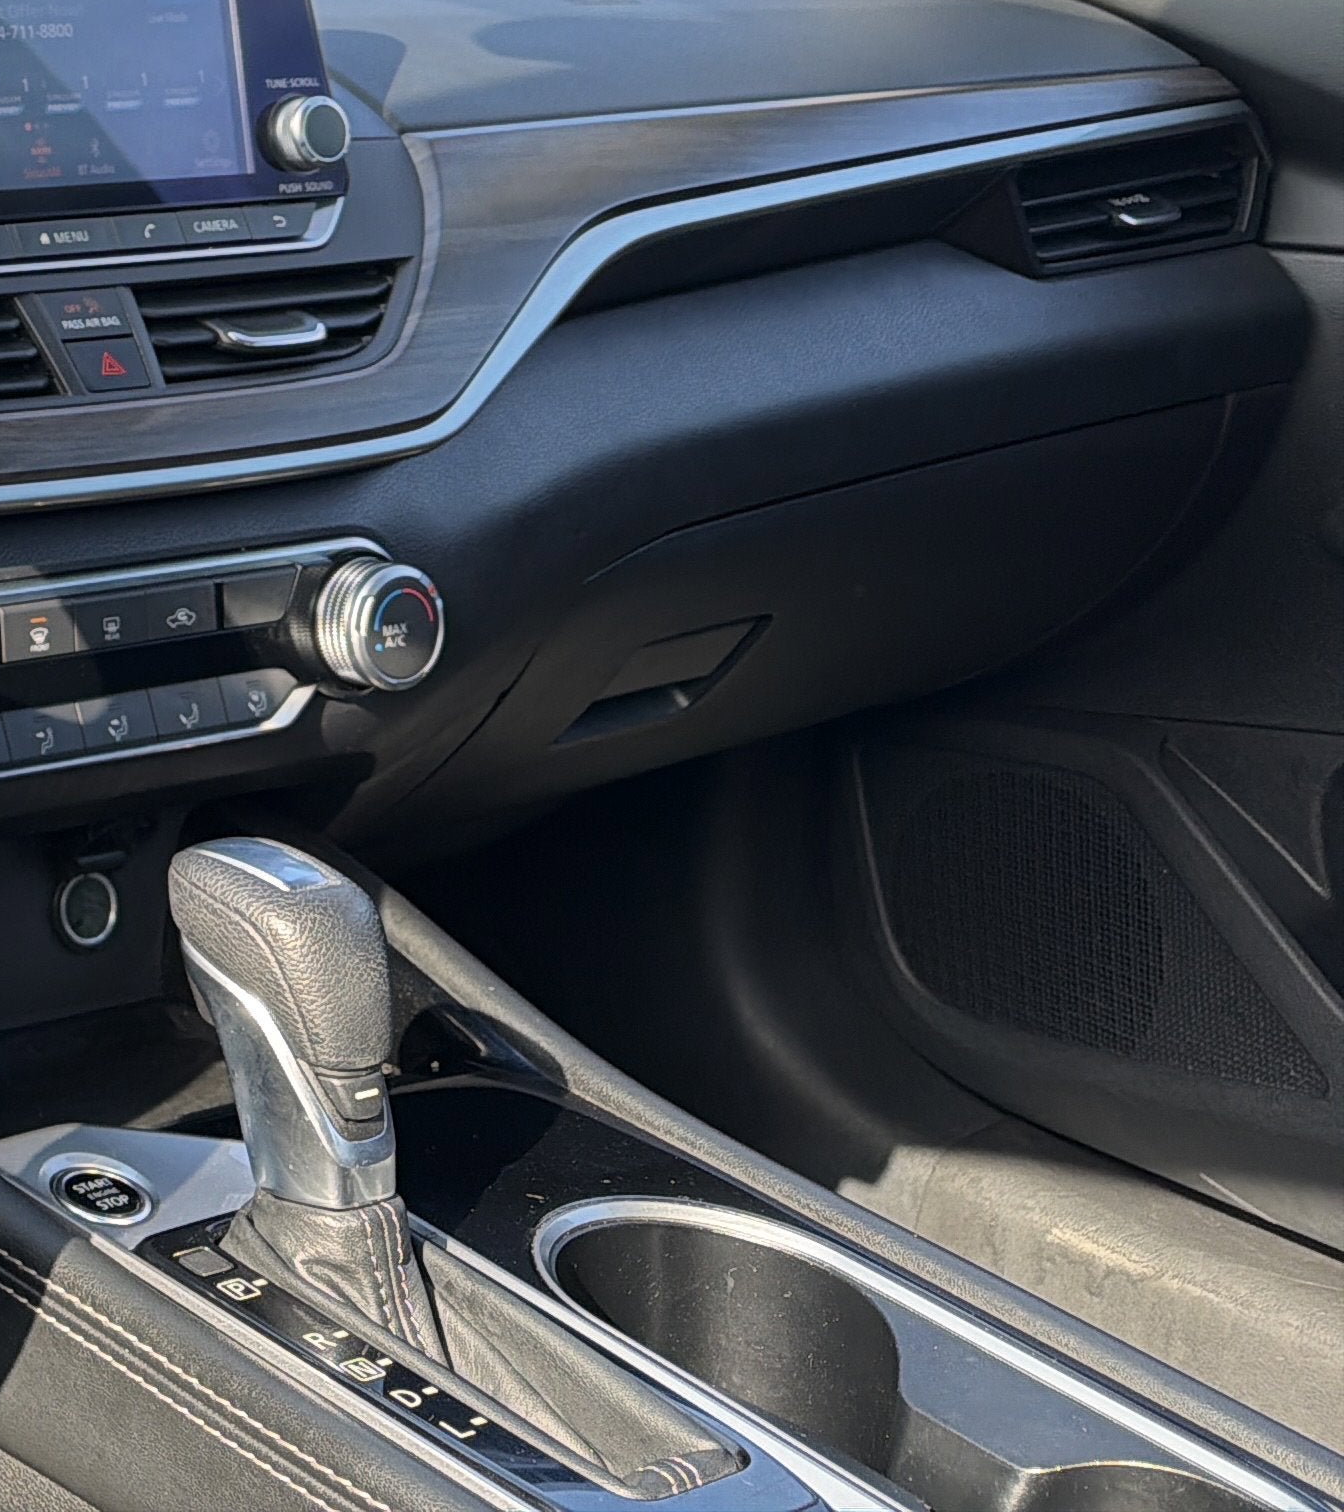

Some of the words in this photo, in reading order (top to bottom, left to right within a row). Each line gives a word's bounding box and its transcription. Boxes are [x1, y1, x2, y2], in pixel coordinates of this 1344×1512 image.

[193, 217, 240, 235] CAMERA
[53, 229, 89, 245] MENU
[382, 622, 408, 637] MAX
[384, 634, 407, 649] A/C
[72, 1177, 113, 1195] START
[95, 1193, 130, 1210] STOP
[302, 1332, 336, 1351] R
[388, 1388, 422, 1409] D
[438, 1420, 477, 1439] L
